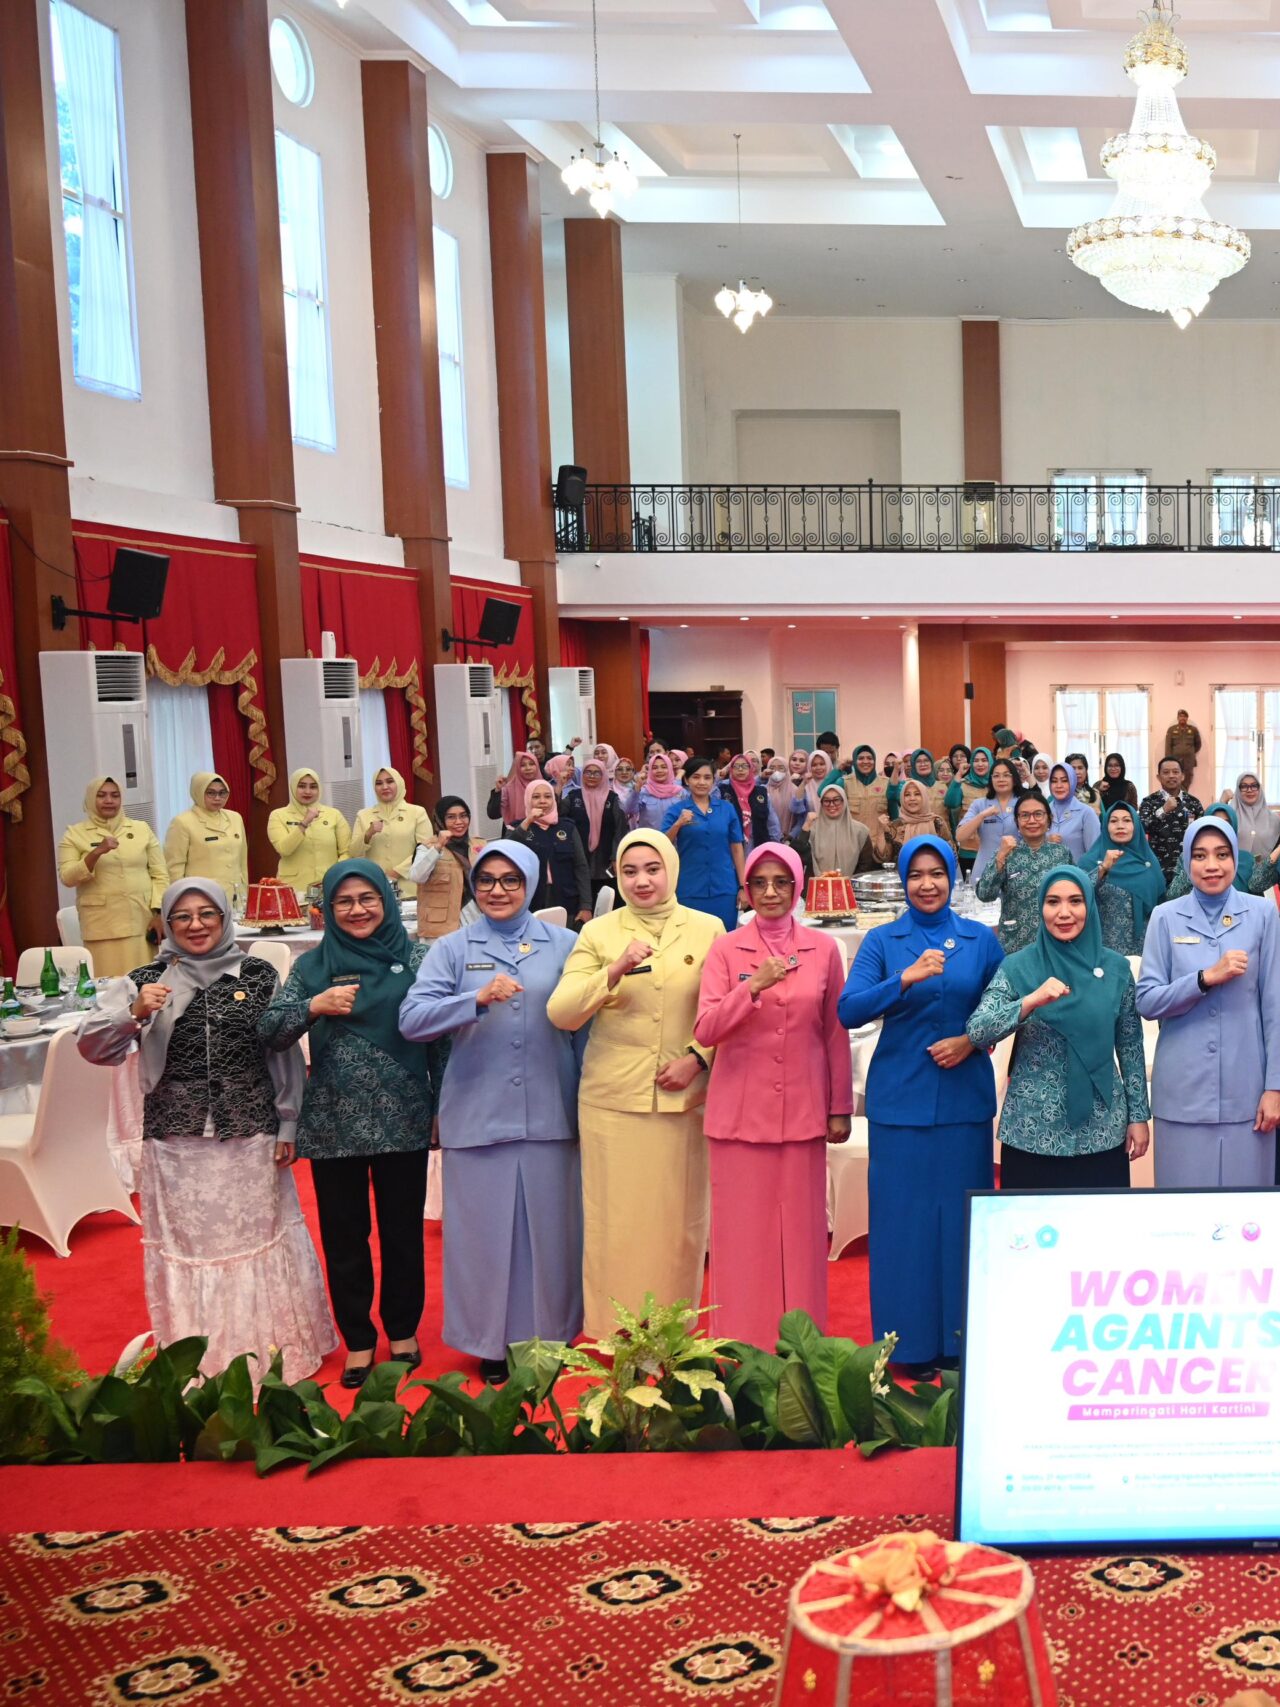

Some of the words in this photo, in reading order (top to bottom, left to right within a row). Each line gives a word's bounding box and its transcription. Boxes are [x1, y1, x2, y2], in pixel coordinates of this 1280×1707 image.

[1082, 1404, 1175, 1418] Memperingati
[1180, 1403, 1207, 1415] Hari
[1212, 1402, 1256, 1414] Kartini
